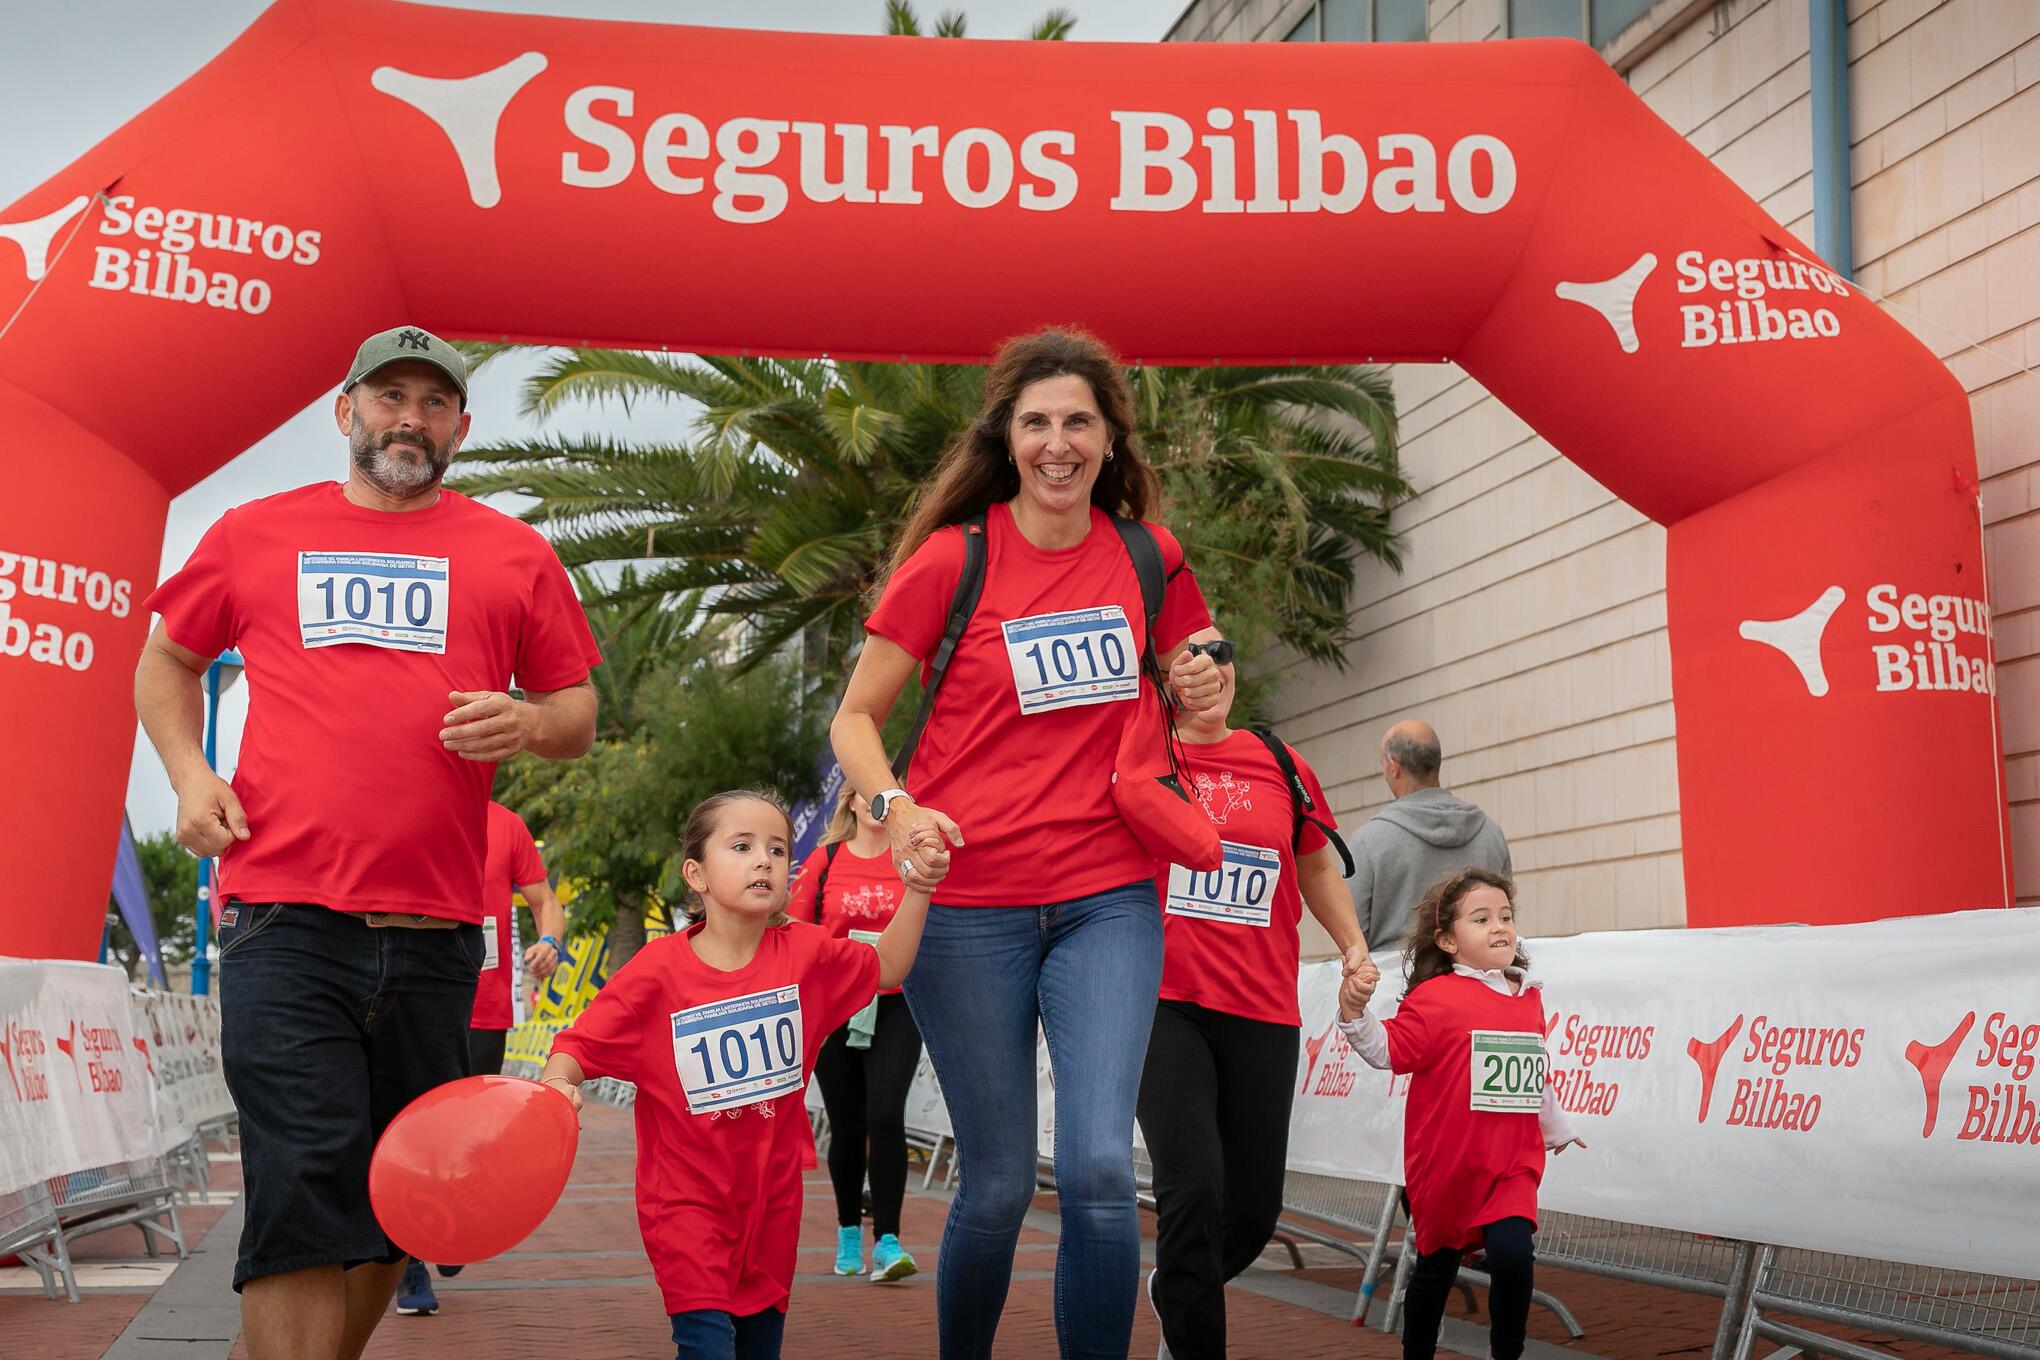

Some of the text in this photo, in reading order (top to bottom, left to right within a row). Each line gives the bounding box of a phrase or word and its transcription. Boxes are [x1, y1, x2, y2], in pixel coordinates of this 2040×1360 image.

[562, 86, 1517, 223] Seguros Bilbao
[99, 195, 321, 266] Seguros
[89, 246, 272, 315] Bilbao
[1676, 251, 1849, 299] Seguros
[1680, 300, 1840, 347] Bilbao
[316, 577, 432, 627] 1010
[1026, 633, 1126, 685] 1010
[1188, 867, 1267, 906] 1010
[691, 1017, 796, 1084] 1010
[1560, 1014, 1655, 1067] Seguros
[1744, 1016, 1865, 1075] Seguros
[1976, 1012, 2040, 1080] Seg
[1314, 1062, 1356, 1097] Bilbao
[1483, 1055, 1545, 1093] 2028
[1552, 1069, 1618, 1116] Bilbao
[1726, 1077, 1821, 1132] Bilbao
